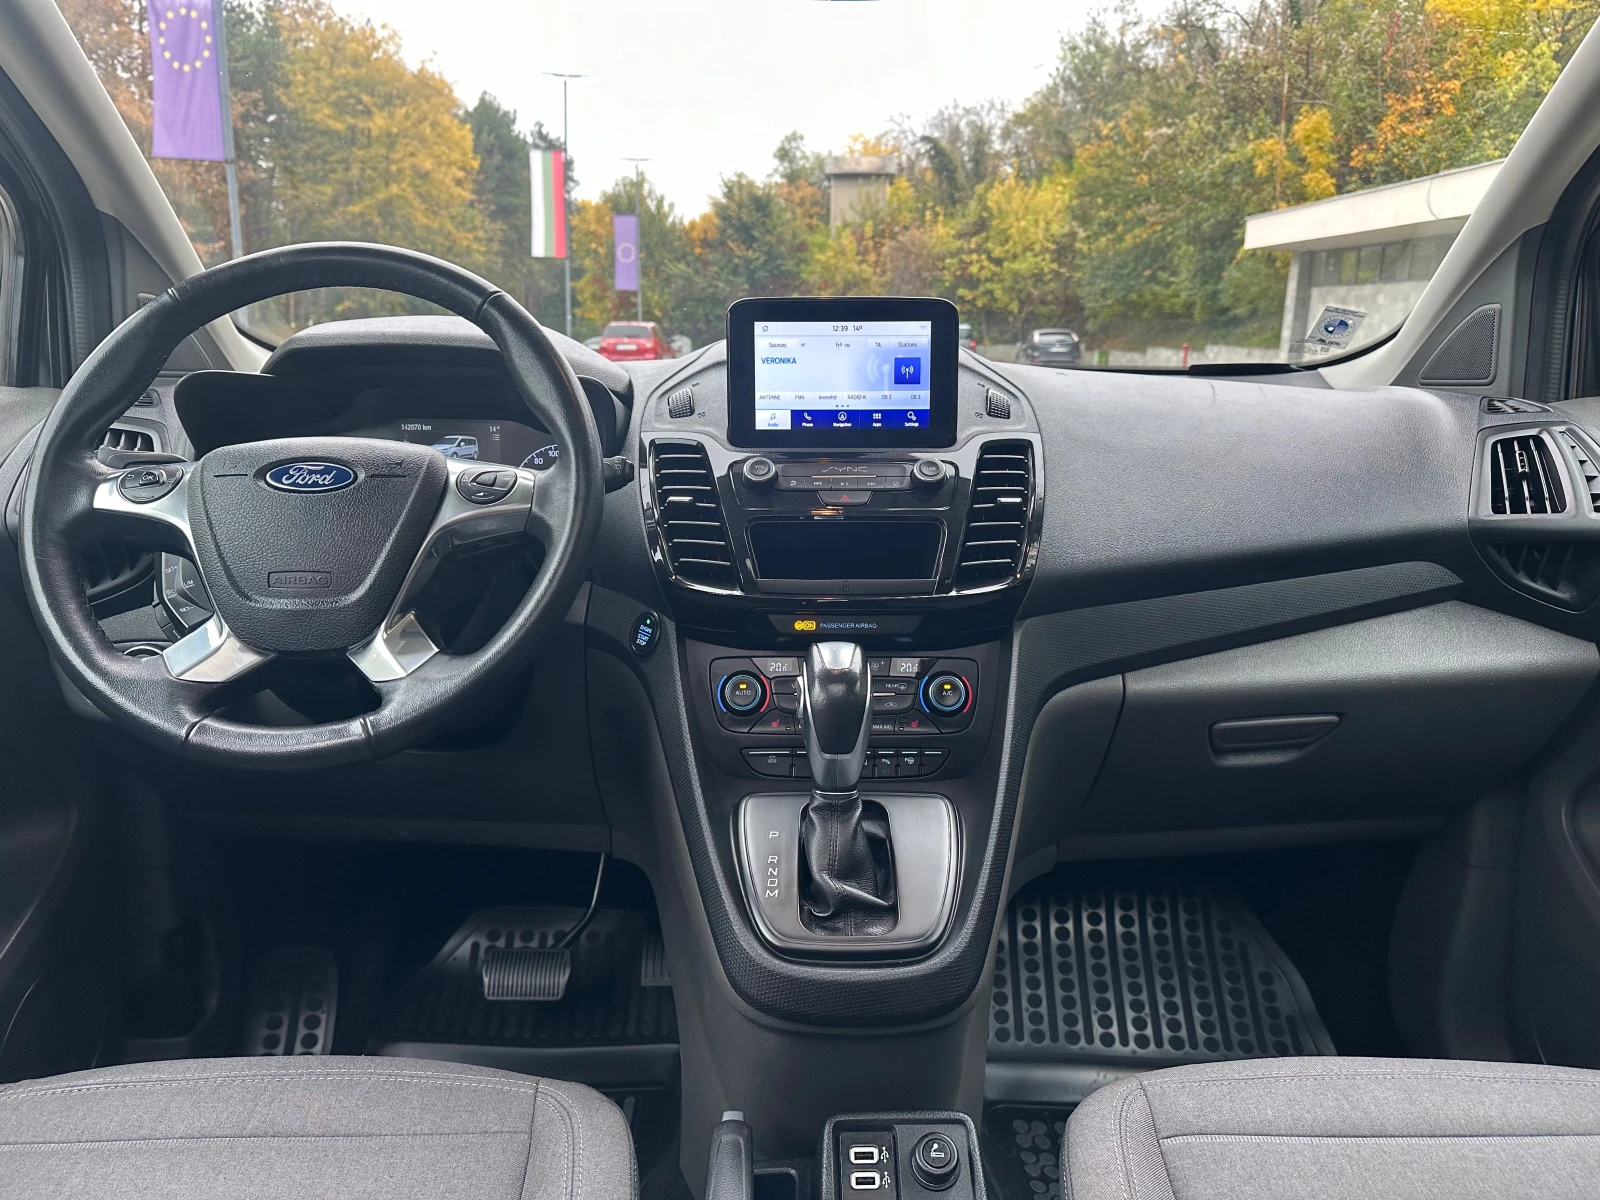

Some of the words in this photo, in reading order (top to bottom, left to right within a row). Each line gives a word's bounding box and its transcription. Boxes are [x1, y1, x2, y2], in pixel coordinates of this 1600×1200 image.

[761, 356, 797, 365] VERONIKA
[534, 457, 544, 465] 80
[281, 464, 337, 485] Ford
[271, 575, 329, 586] AIRBAG
[636, 638, 647, 646] STOP
[769, 831, 779, 839] P
[767, 855, 778, 864] R
[767, 867, 778, 876] N
[767, 878, 778, 887] D
[765, 889, 779, 898] M
